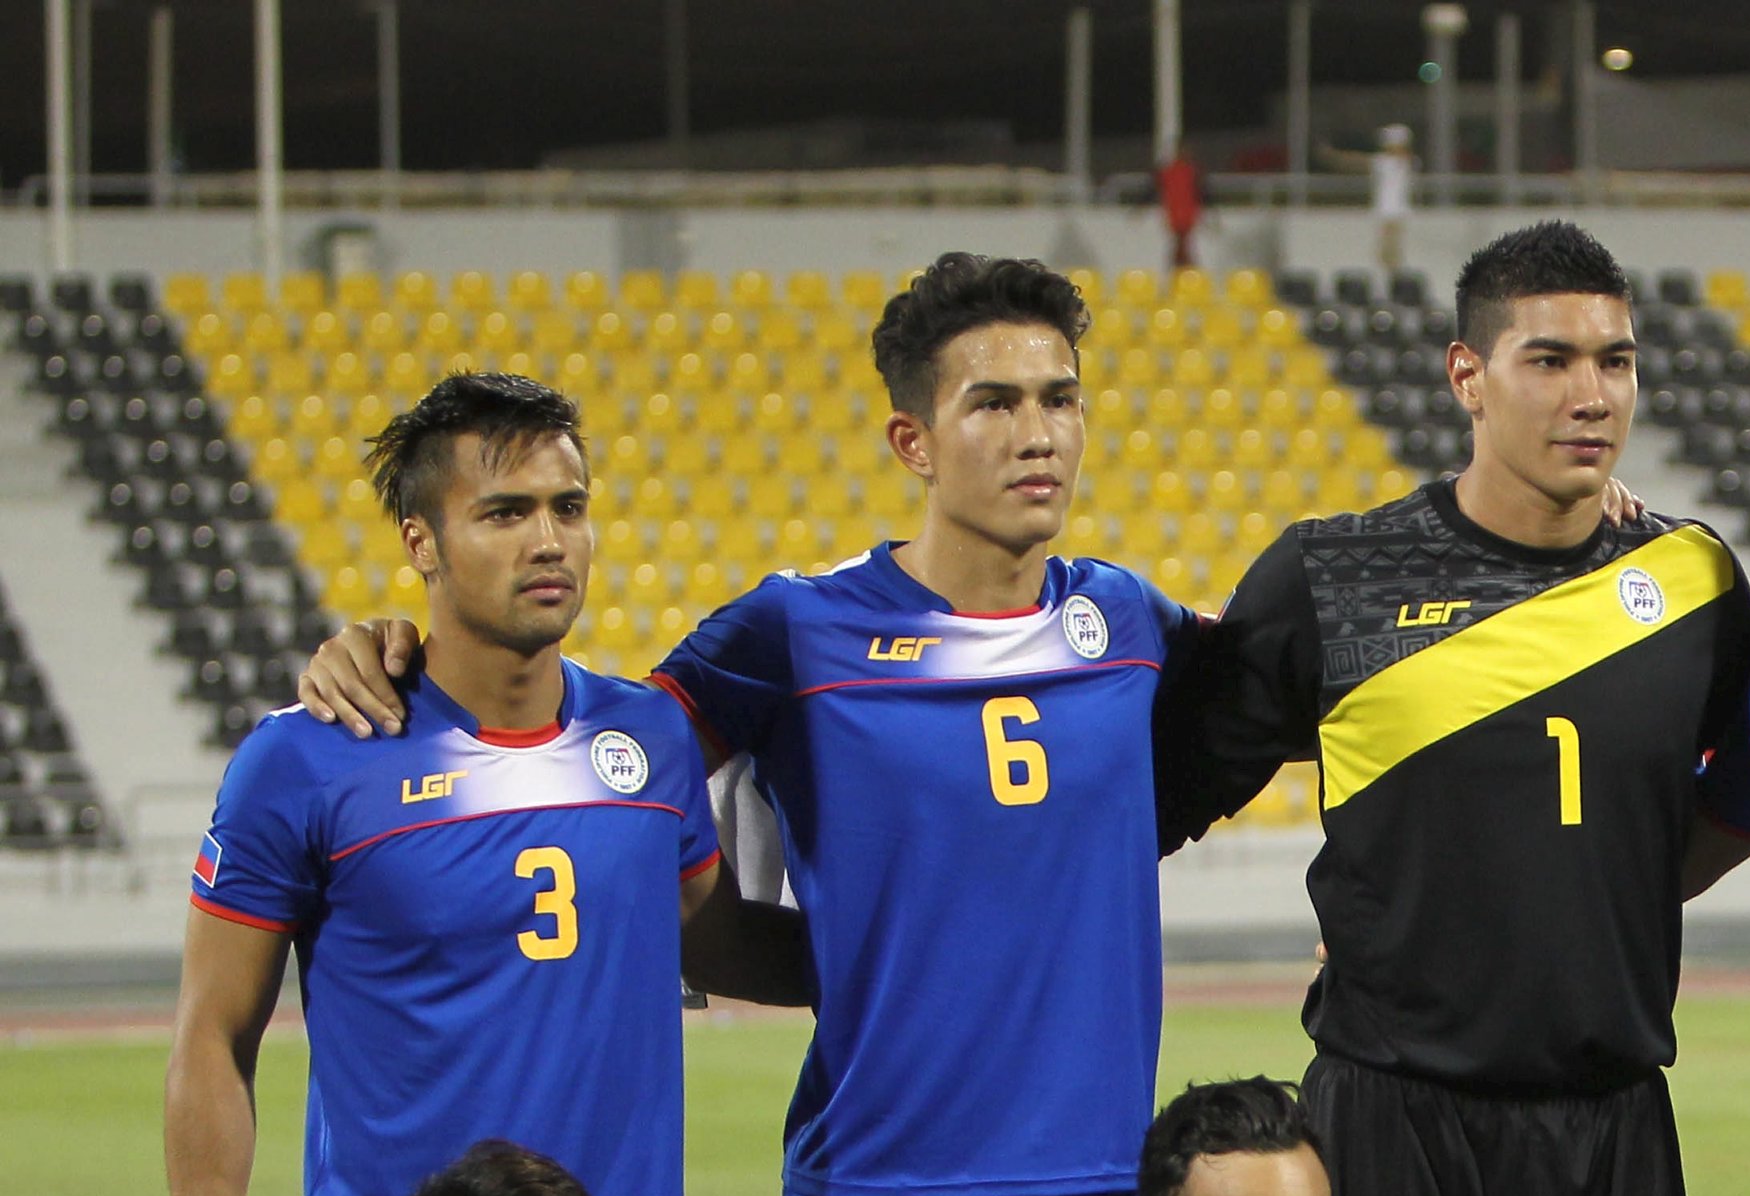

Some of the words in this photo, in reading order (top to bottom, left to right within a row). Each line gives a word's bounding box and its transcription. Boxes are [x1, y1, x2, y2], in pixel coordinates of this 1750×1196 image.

[1634, 598, 1656, 609] PFF
[1079, 630, 1099, 642] PFF
[611, 765, 636, 777] PFF
[981, 695, 1050, 806] 6
[1546, 717, 1583, 825] 1
[515, 848, 579, 961] 3
